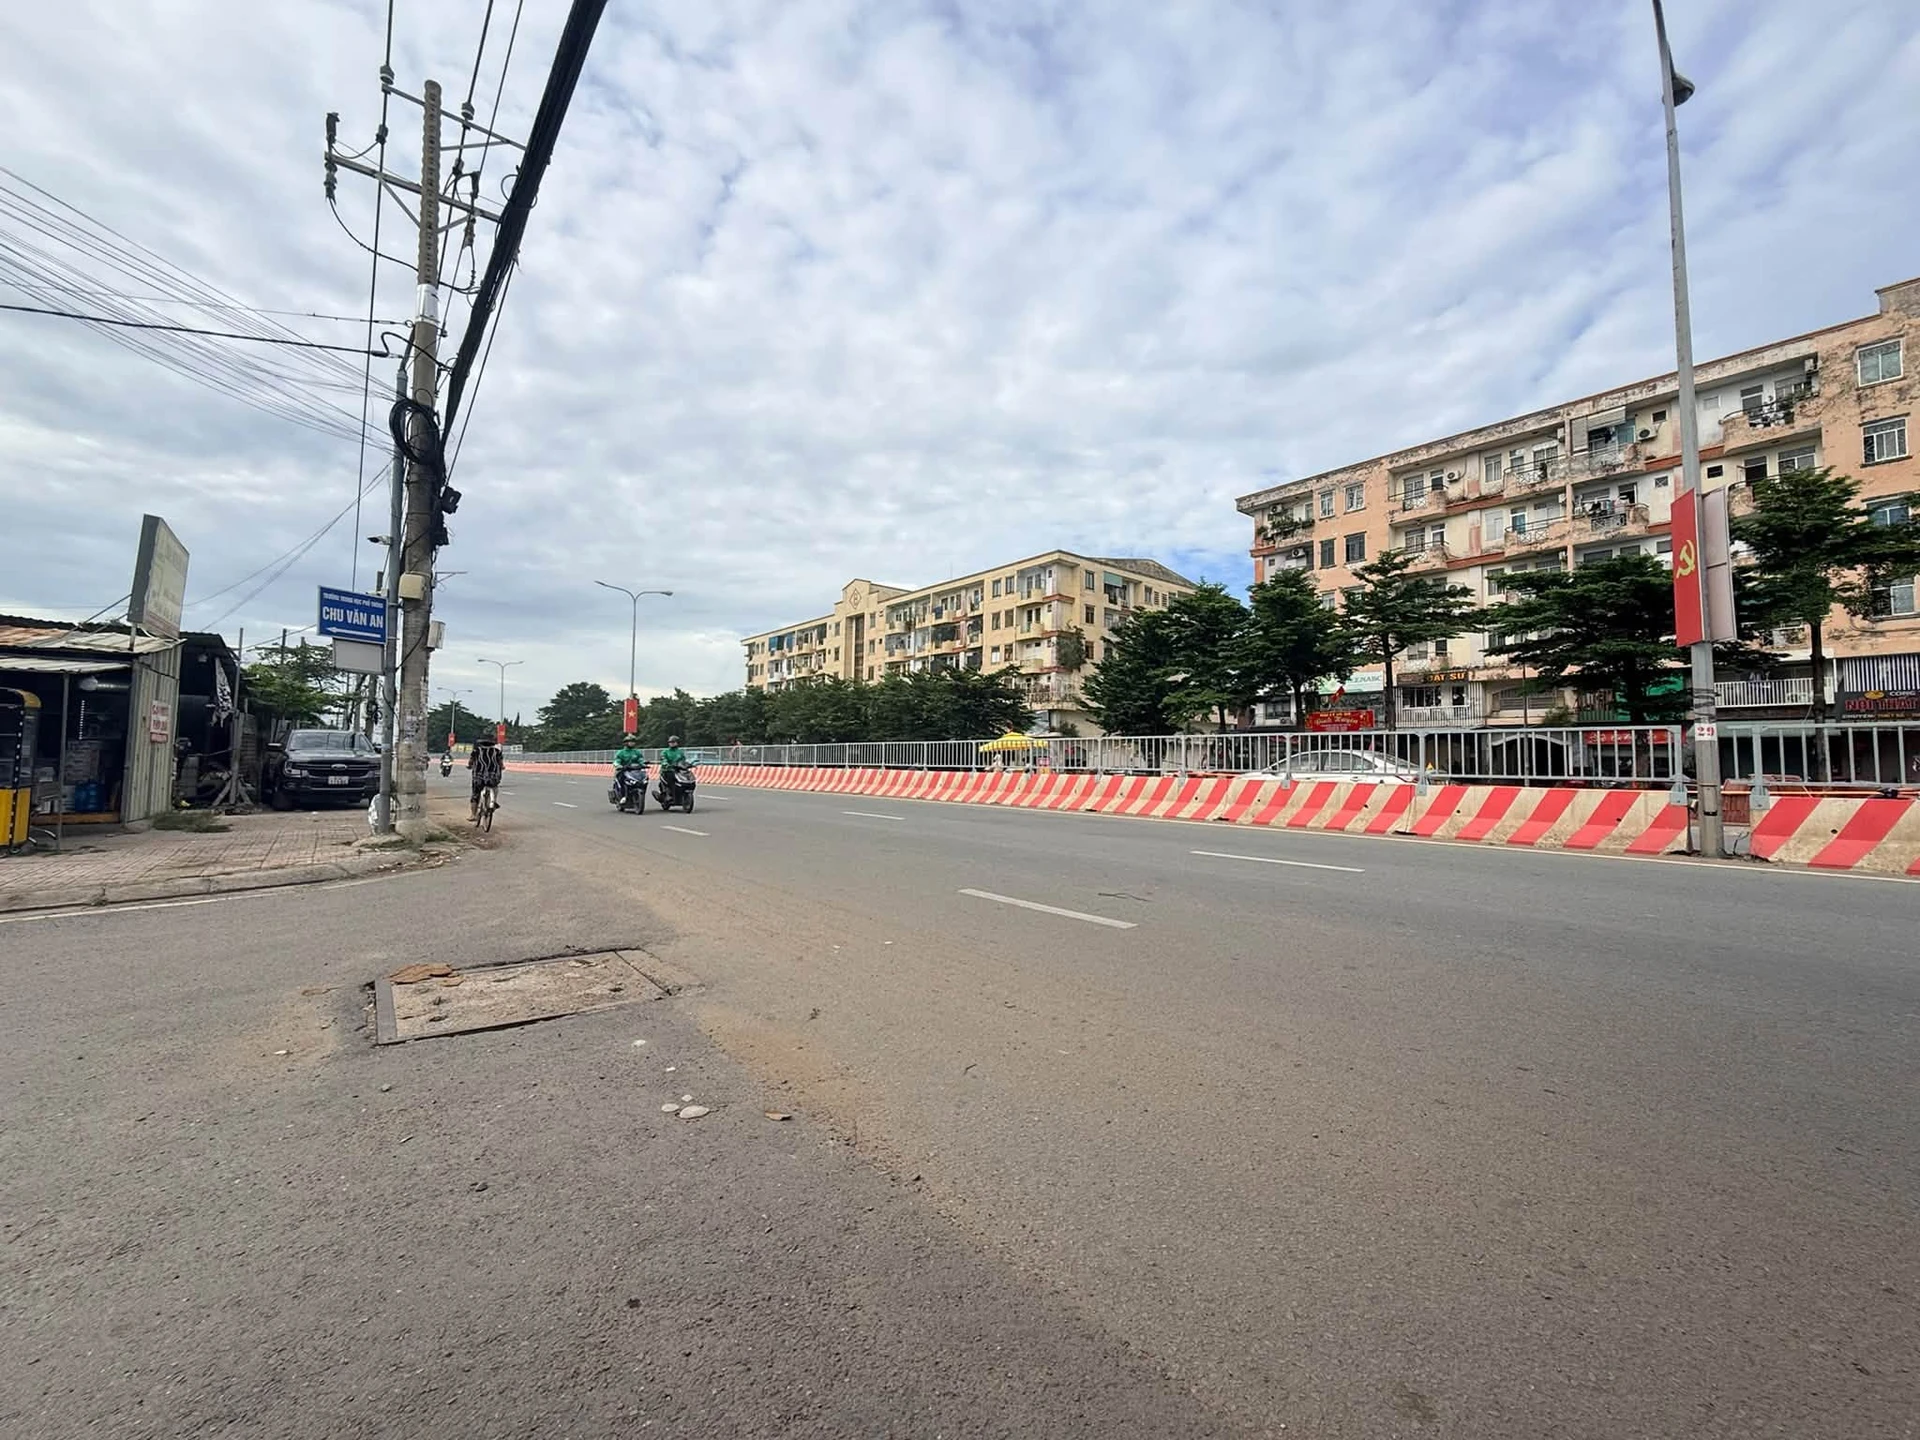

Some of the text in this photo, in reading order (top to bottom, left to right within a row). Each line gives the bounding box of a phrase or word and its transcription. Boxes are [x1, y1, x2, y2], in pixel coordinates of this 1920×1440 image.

[322, 606, 383, 628] CHU VĂN AN
[1697, 726, 1714, 737] 29
